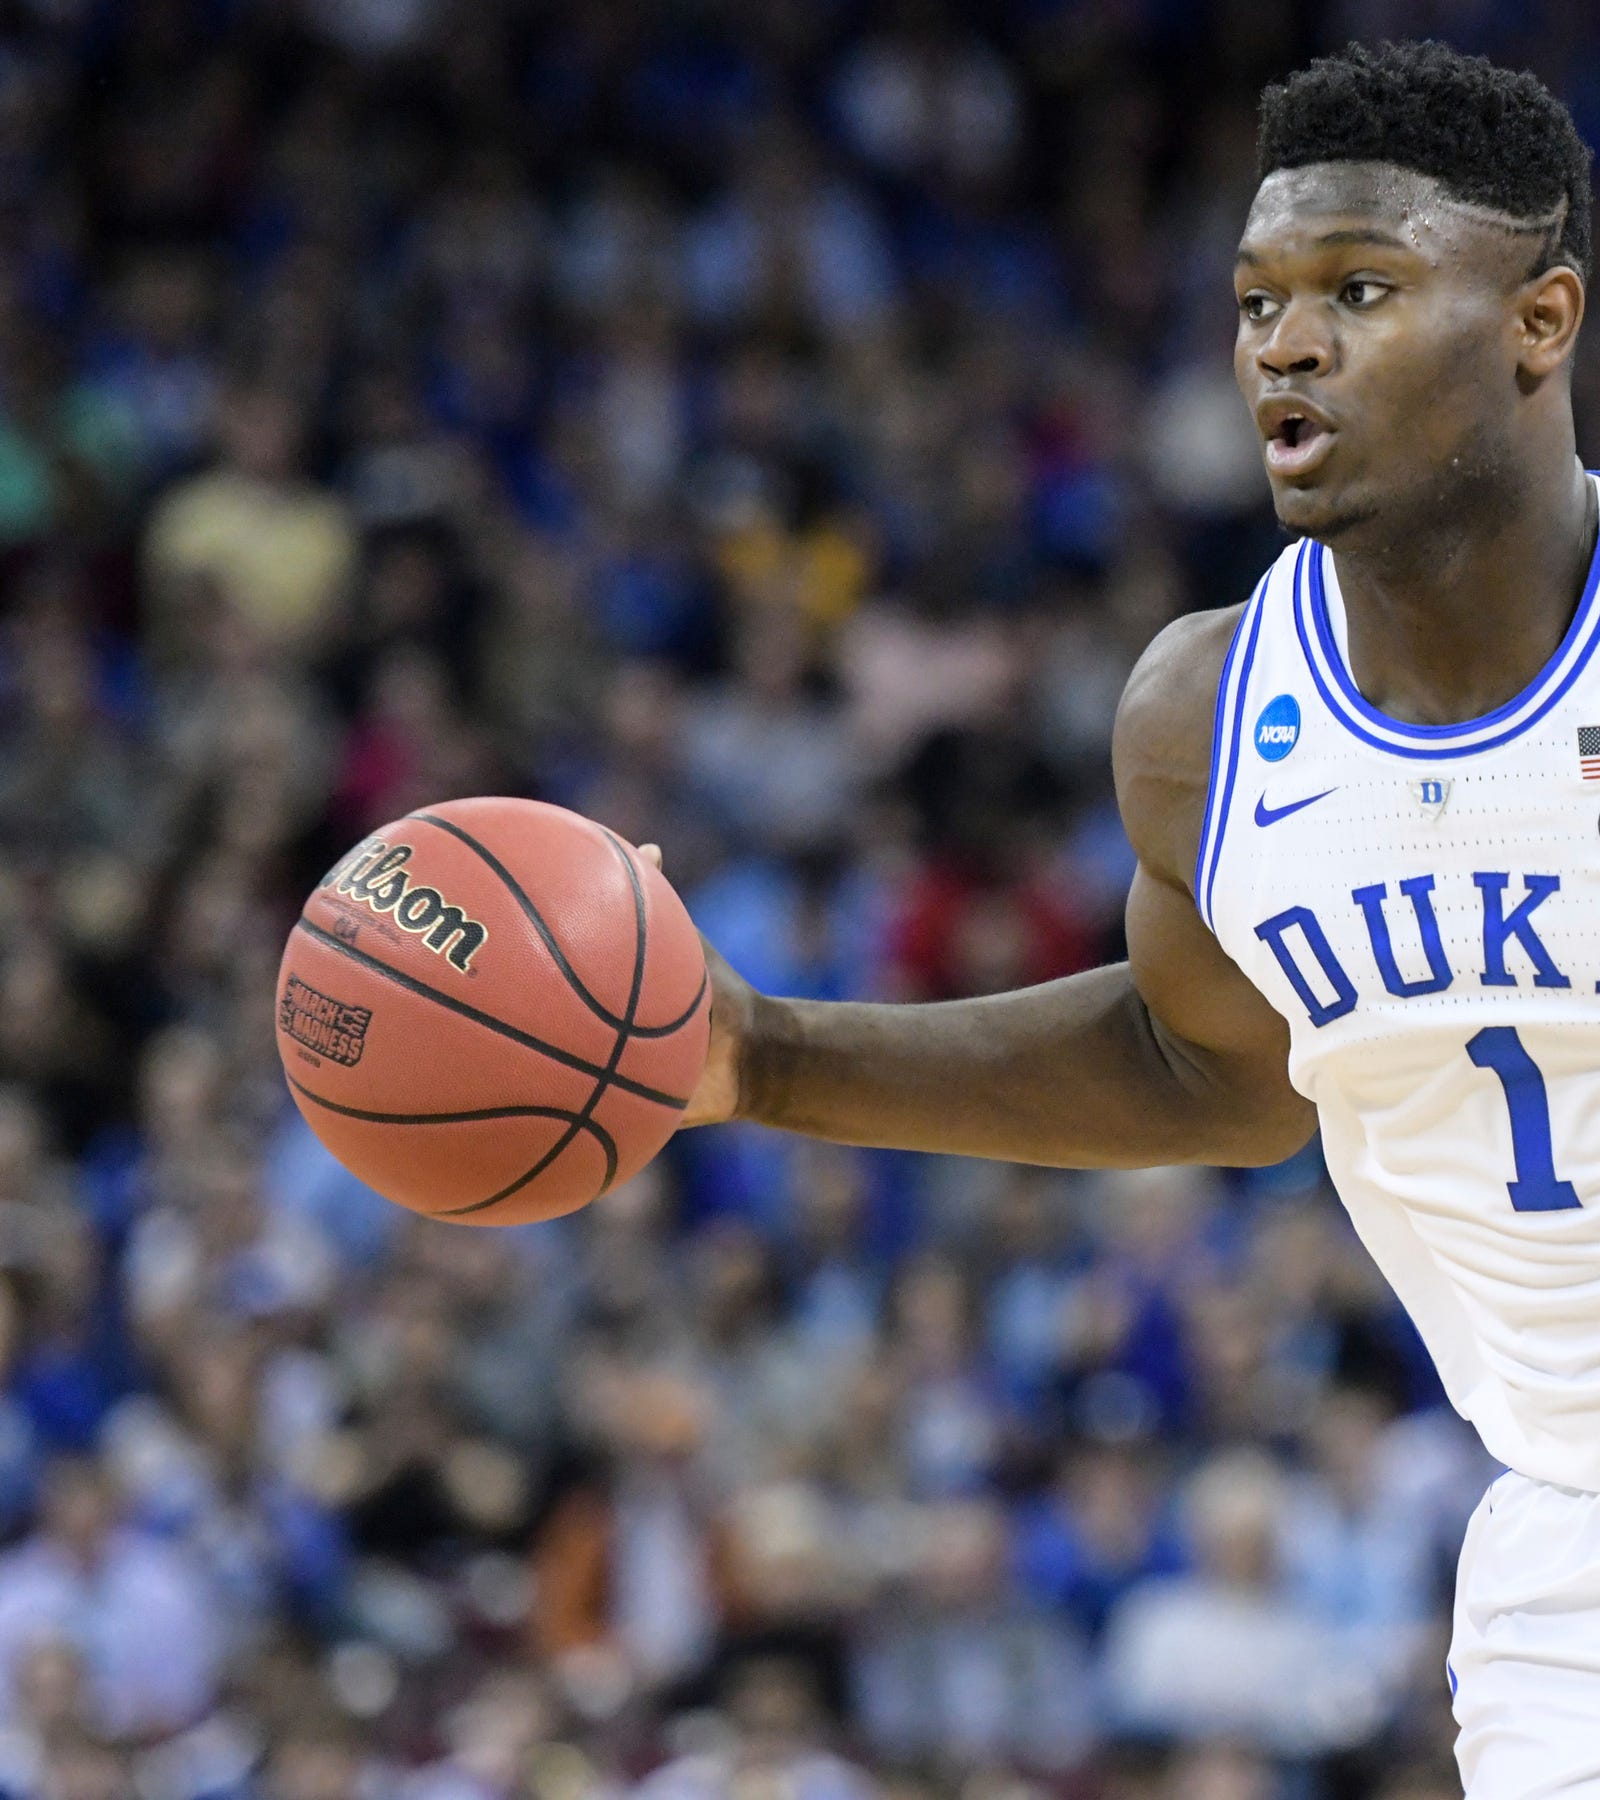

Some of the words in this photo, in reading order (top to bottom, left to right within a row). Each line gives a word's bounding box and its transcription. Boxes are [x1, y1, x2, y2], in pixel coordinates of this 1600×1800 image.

[1258, 725, 1297, 744] NCAA
[292, 1010, 362, 1060] MADNESS
[1465, 1026, 1584, 1213] 1
